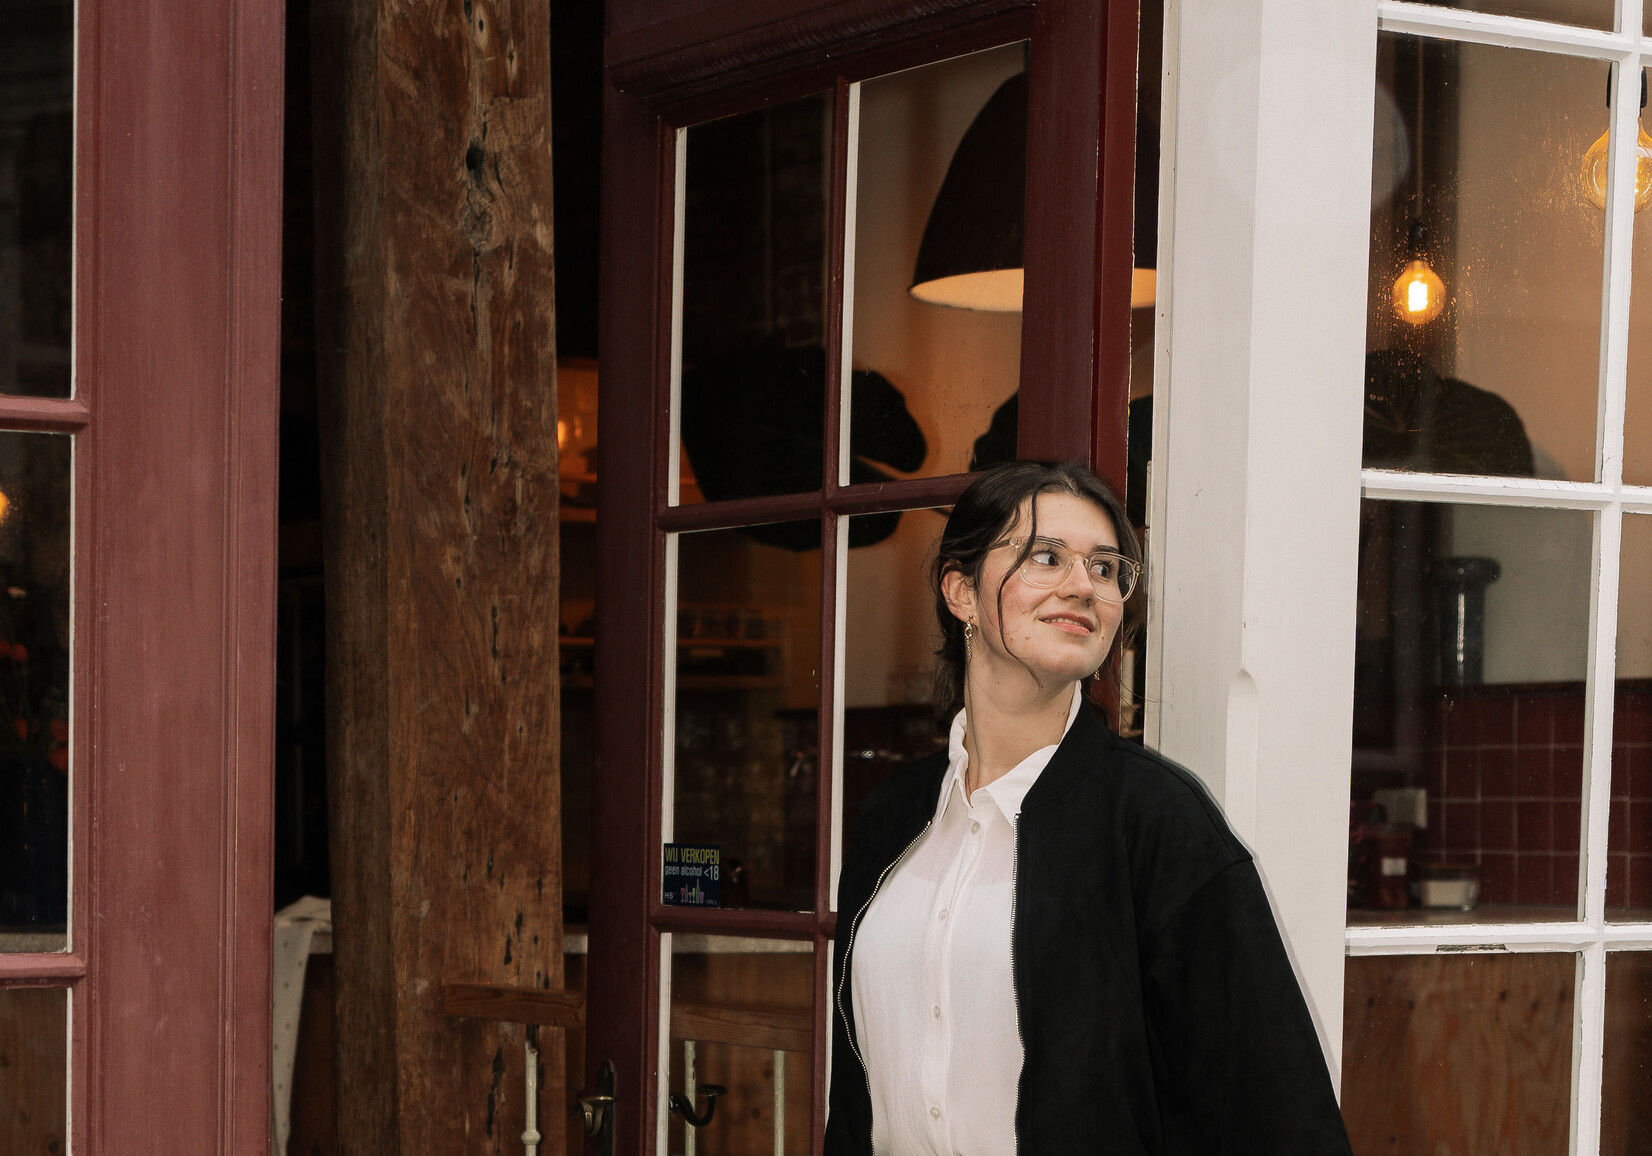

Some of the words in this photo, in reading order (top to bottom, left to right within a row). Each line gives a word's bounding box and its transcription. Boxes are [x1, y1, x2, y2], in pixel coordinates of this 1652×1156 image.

[665, 847, 678, 862] WIJ
[680, 848, 720, 865] VERKOPEN
[664, 865, 680, 876] geen
[680, 865, 703, 877] alcohol
[704, 865, 720, 880] <18
